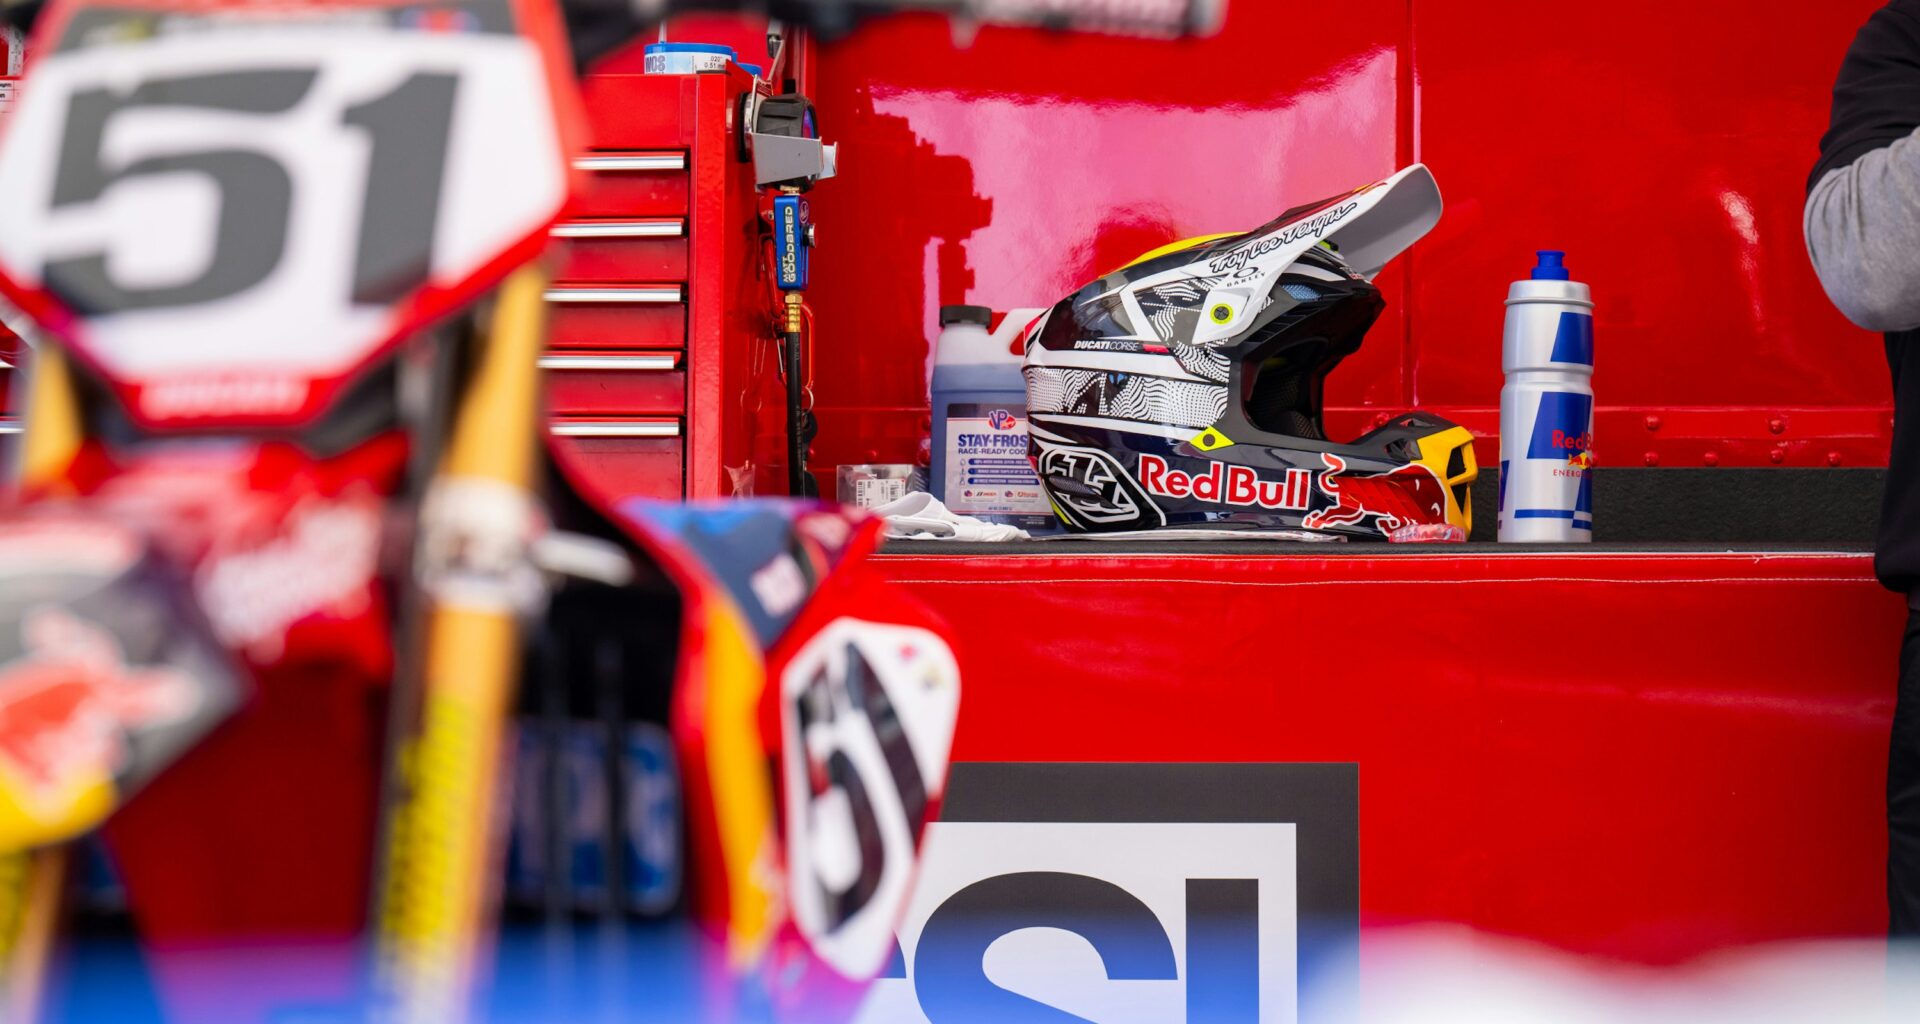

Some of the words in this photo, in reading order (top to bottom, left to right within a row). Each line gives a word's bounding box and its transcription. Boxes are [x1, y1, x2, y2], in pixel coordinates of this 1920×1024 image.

[44, 66, 462, 309] 51
[785, 206, 796, 283] GOODBRED
[1210, 248, 1249, 273] Troy
[1250, 237, 1284, 260] Lee
[1226, 271, 1266, 288] OAKLEY
[988, 409, 1009, 431] VP
[958, 434, 1028, 447] STAY-FROS
[1552, 429, 1585, 450] Red
[1138, 453, 1224, 503] Red
[1225, 464, 1312, 511] Bull
[798, 641, 928, 936] 51
